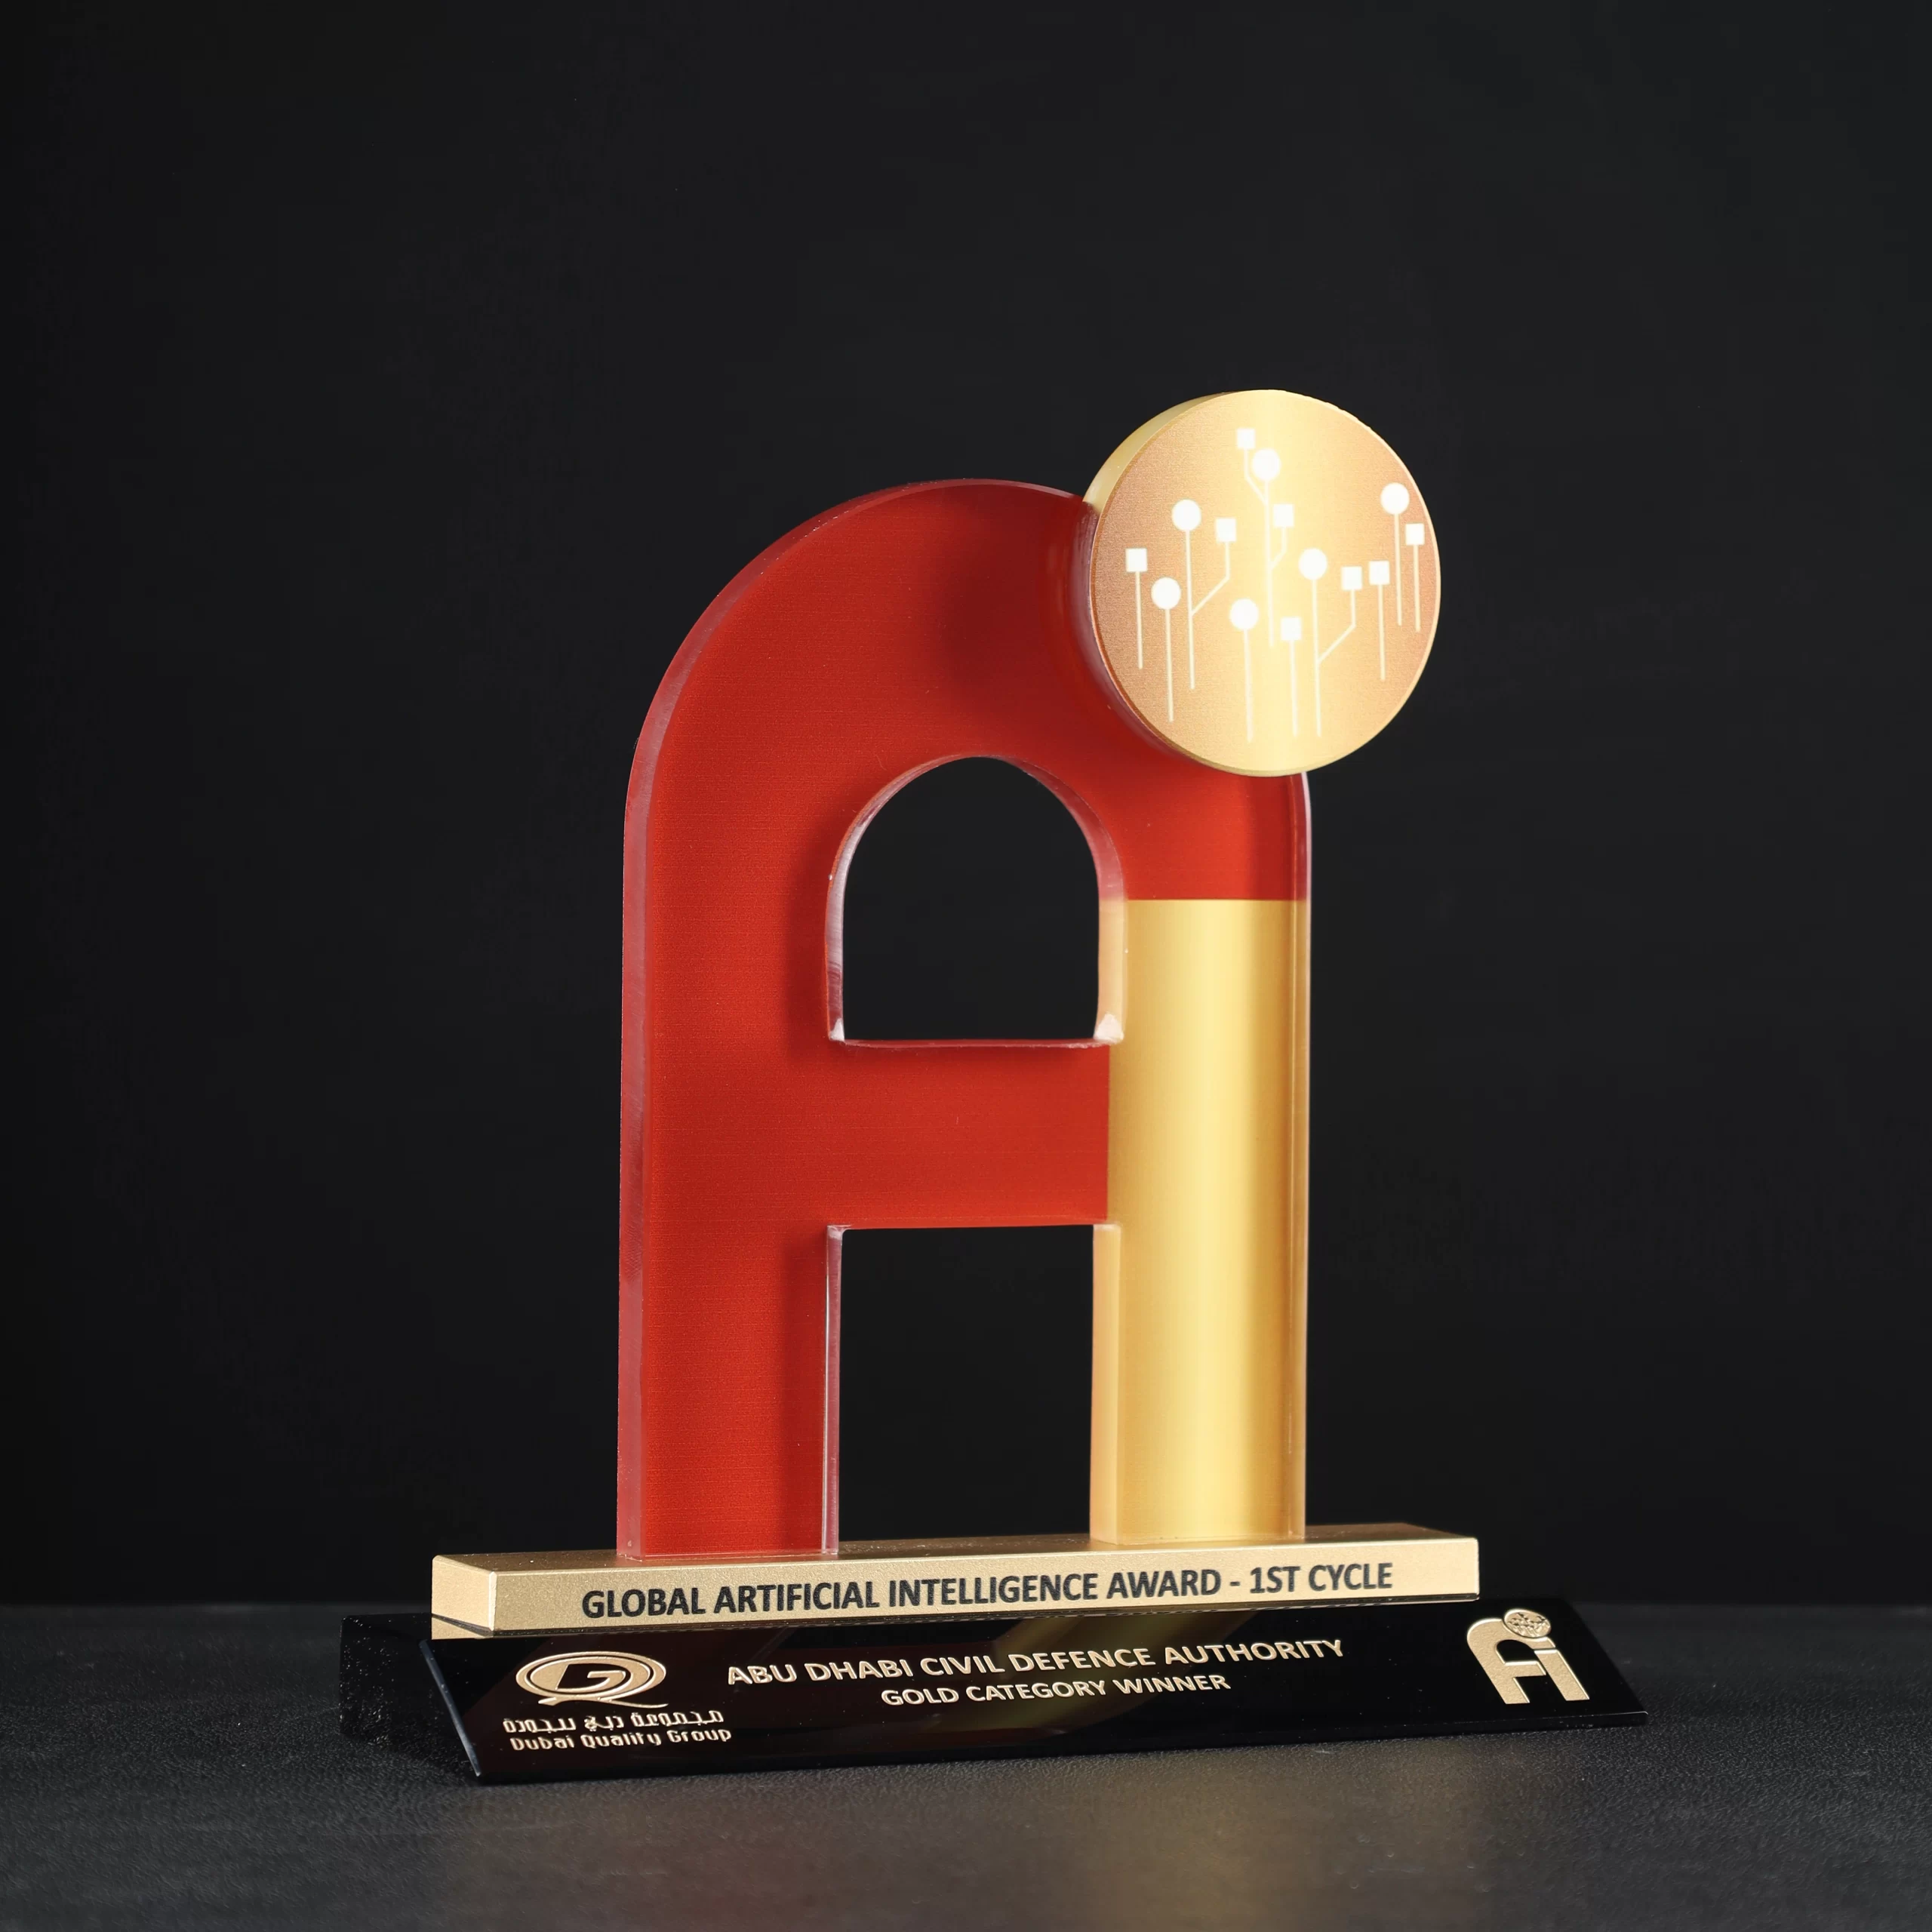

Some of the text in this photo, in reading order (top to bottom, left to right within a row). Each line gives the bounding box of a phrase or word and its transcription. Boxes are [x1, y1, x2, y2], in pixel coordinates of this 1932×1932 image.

[582, 1587, 706, 1618] GLOBAL
[714, 1581, 880, 1614] ARTIFICIAL
[888, 1573, 1098, 1607] INTELLIGENCE
[1106, 1568, 1221, 1599] AWARD
[1250, 1565, 1300, 1594] 1ST
[1308, 1562, 1393, 1590] CYCLE
[728, 1639, 1343, 1685] ABU DHABI CIVIL DEFENCE AUTHORITY
[881, 1674, 1232, 1706] GOLD CATEGORY WINNER
[502, 1716, 577, 1734] للجودة
[630, 1709, 724, 1727] مجموعة
[509, 1728, 732, 1751] Dubai Quality Group
